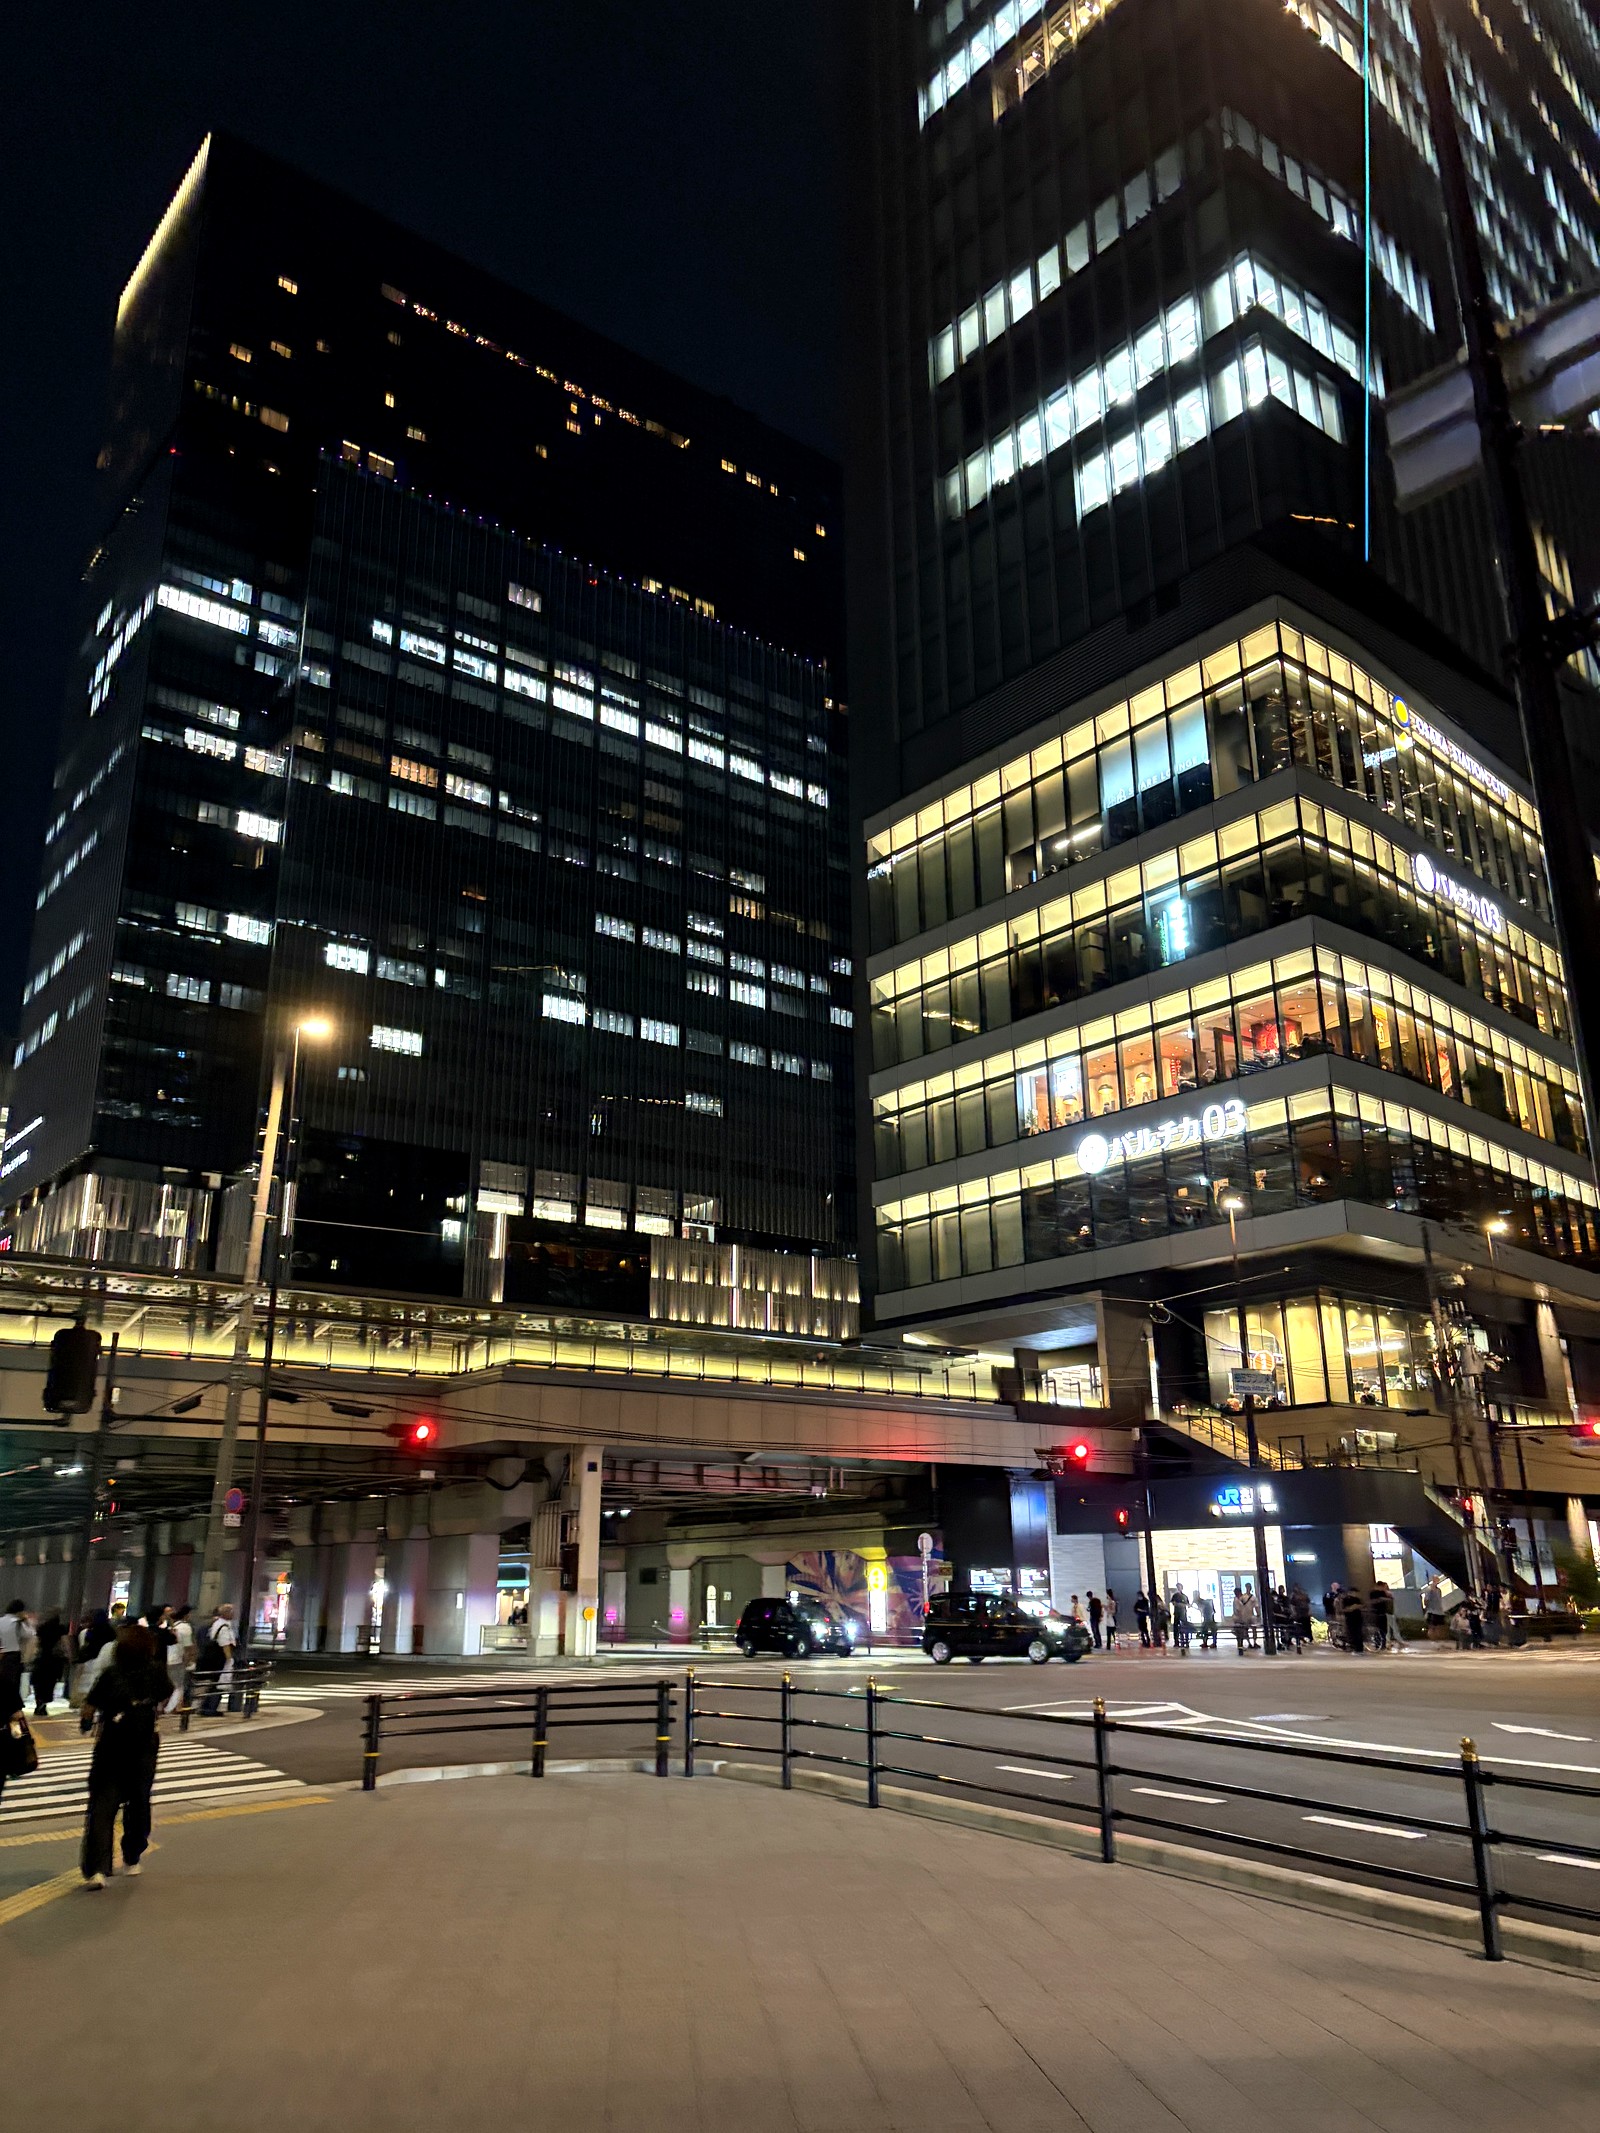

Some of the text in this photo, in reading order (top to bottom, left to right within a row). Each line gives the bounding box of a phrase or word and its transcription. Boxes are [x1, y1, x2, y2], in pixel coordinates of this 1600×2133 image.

[1128, 775, 1158, 796] SARE
[1109, 1099, 1247, 1162] バルチカ03
